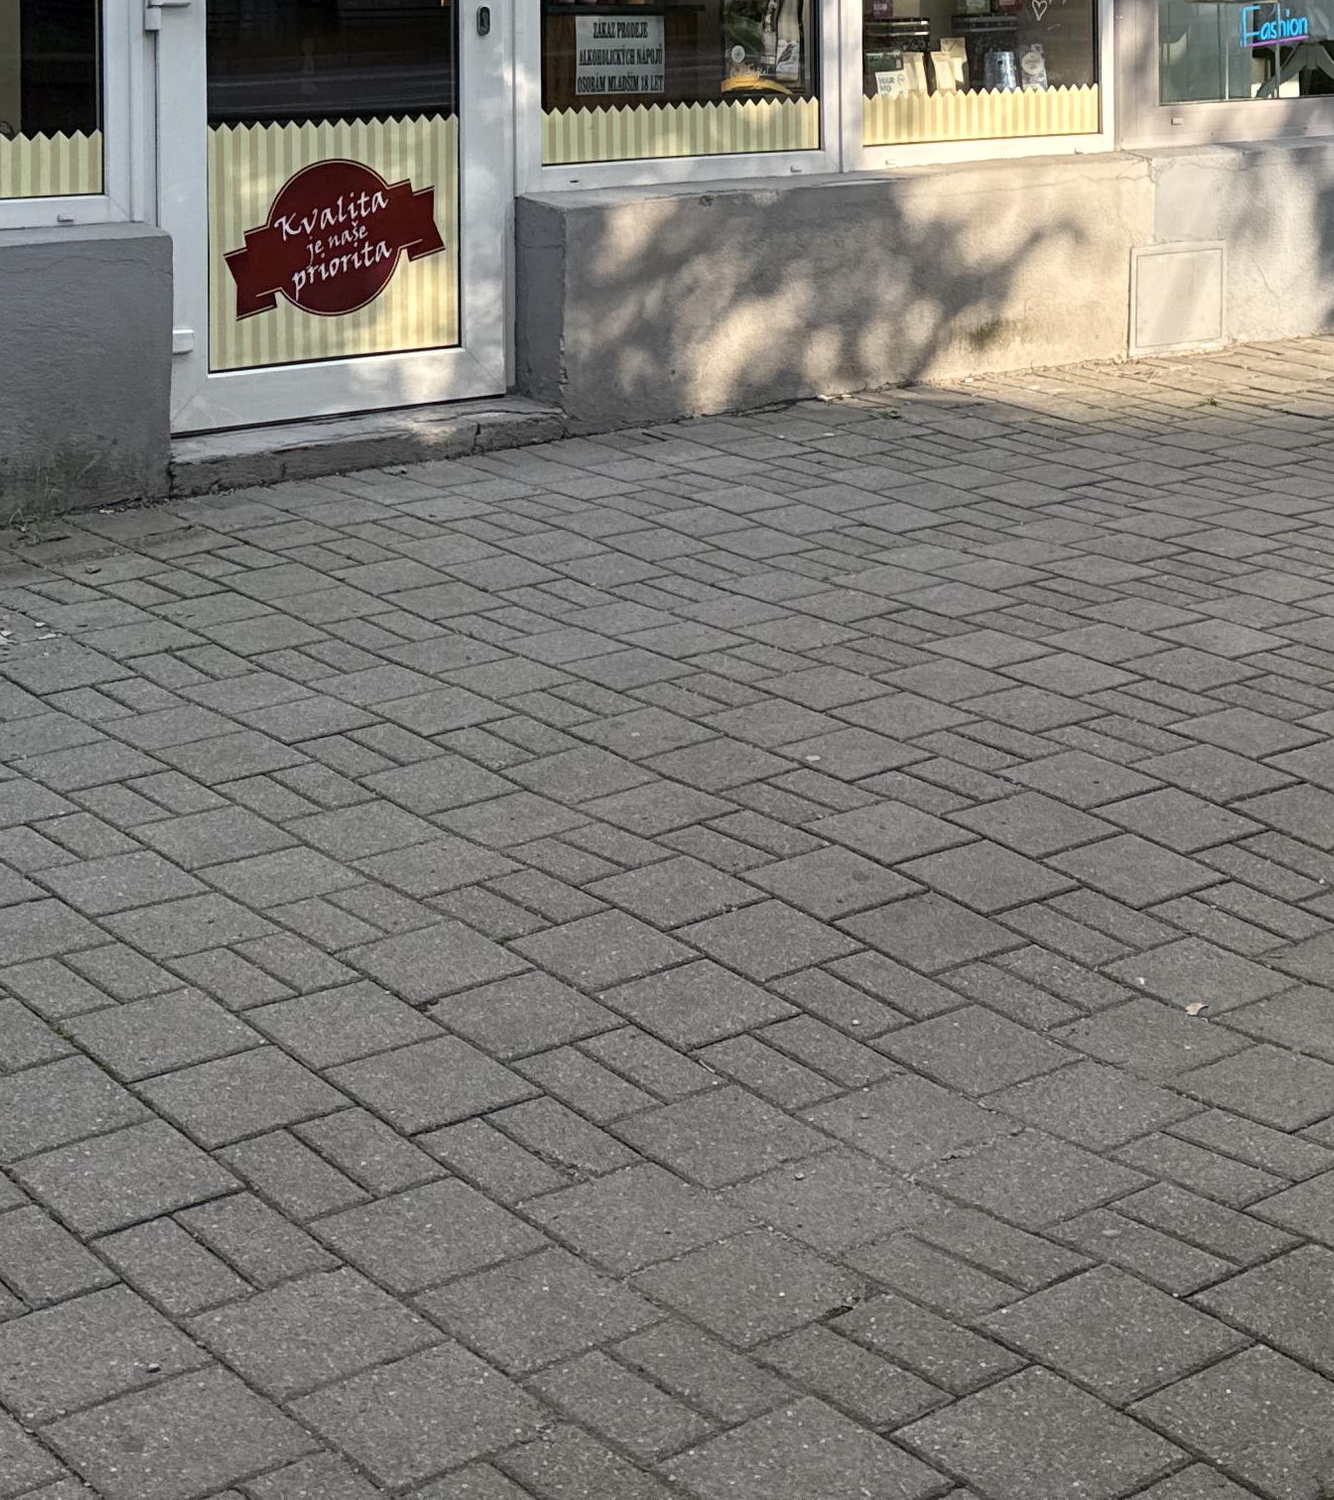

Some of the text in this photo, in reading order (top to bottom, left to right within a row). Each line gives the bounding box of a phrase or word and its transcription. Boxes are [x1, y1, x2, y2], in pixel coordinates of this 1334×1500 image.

[592, 18, 616, 39] ZÁKAZ
[1240, 3, 1309, 48] Fashion
[650, 75, 664, 92] LET
[273, 190, 389, 242] Kvalita
[306, 220, 369, 270] je naše
[291, 240, 393, 301] priorita
